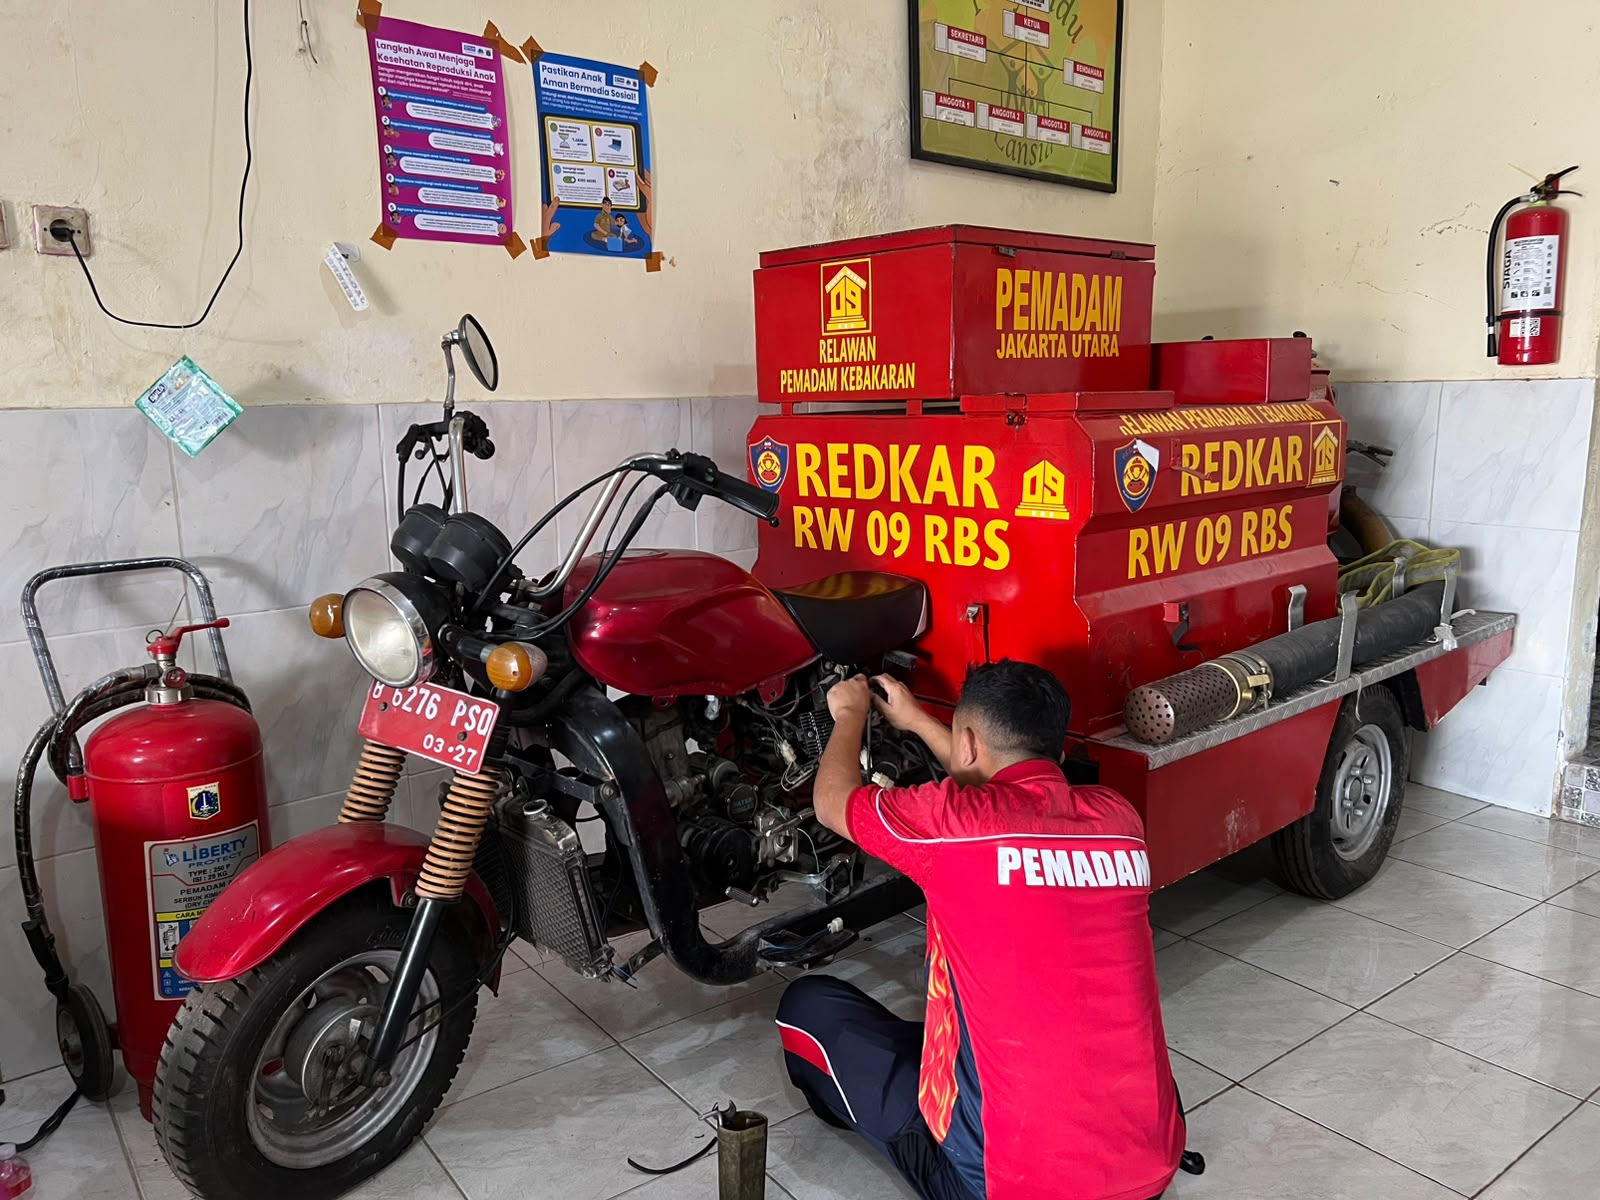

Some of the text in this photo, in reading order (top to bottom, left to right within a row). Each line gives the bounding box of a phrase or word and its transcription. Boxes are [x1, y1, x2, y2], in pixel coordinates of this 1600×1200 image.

[1023, 18, 1041, 29] KETUA
[950, 29, 984, 45] SEKRETARIS
[376, 40, 474, 67] Langkah Awal Menjaga
[378, 53, 495, 81] Kesehatan Reproduksi Anak
[542, 64, 580, 79] Pastikan
[581, 72, 603, 83] Anak
[1076, 64, 1102, 78] BENDAHARA
[543, 78, 637, 101] Aman Bermedia Sosial!
[940, 96, 965, 109] ANGGOTA
[992, 108, 1016, 119] ANGGOTA
[1041, 118, 1062, 130] ANGGOTA
[1084, 128, 1104, 138] ANGGOTA
[1503, 249, 1512, 289] SIAGA
[996, 268, 1123, 332] PEMADAM
[819, 336, 877, 364] RELAWAN
[996, 333, 1120, 359] JAKARTA UTARA
[780, 362, 916, 394] PEMADAM KEBAKARAN
[1180, 407, 1257, 429] PEMADAM
[796, 443, 999, 509] REDKAR
[1181, 435, 1303, 497] REDKAR
[793, 505, 1010, 571] RW 09 RBS
[1127, 504, 1294, 580] RW 09 RBS
[392, 685, 441, 720] 6276
[183, 836, 248, 862] LIBERTY
[188, 851, 243, 868] PROTECT
[188, 868, 208, 878] TYPE
[213, 865, 225, 873] 250
[208, 873, 216, 881] 25
[998, 846, 1150, 888] PEMADAM
[174, 895, 203, 904] SERBUK
[180, 881, 226, 896] PEMADAM
[175, 910, 196, 919] CARA
